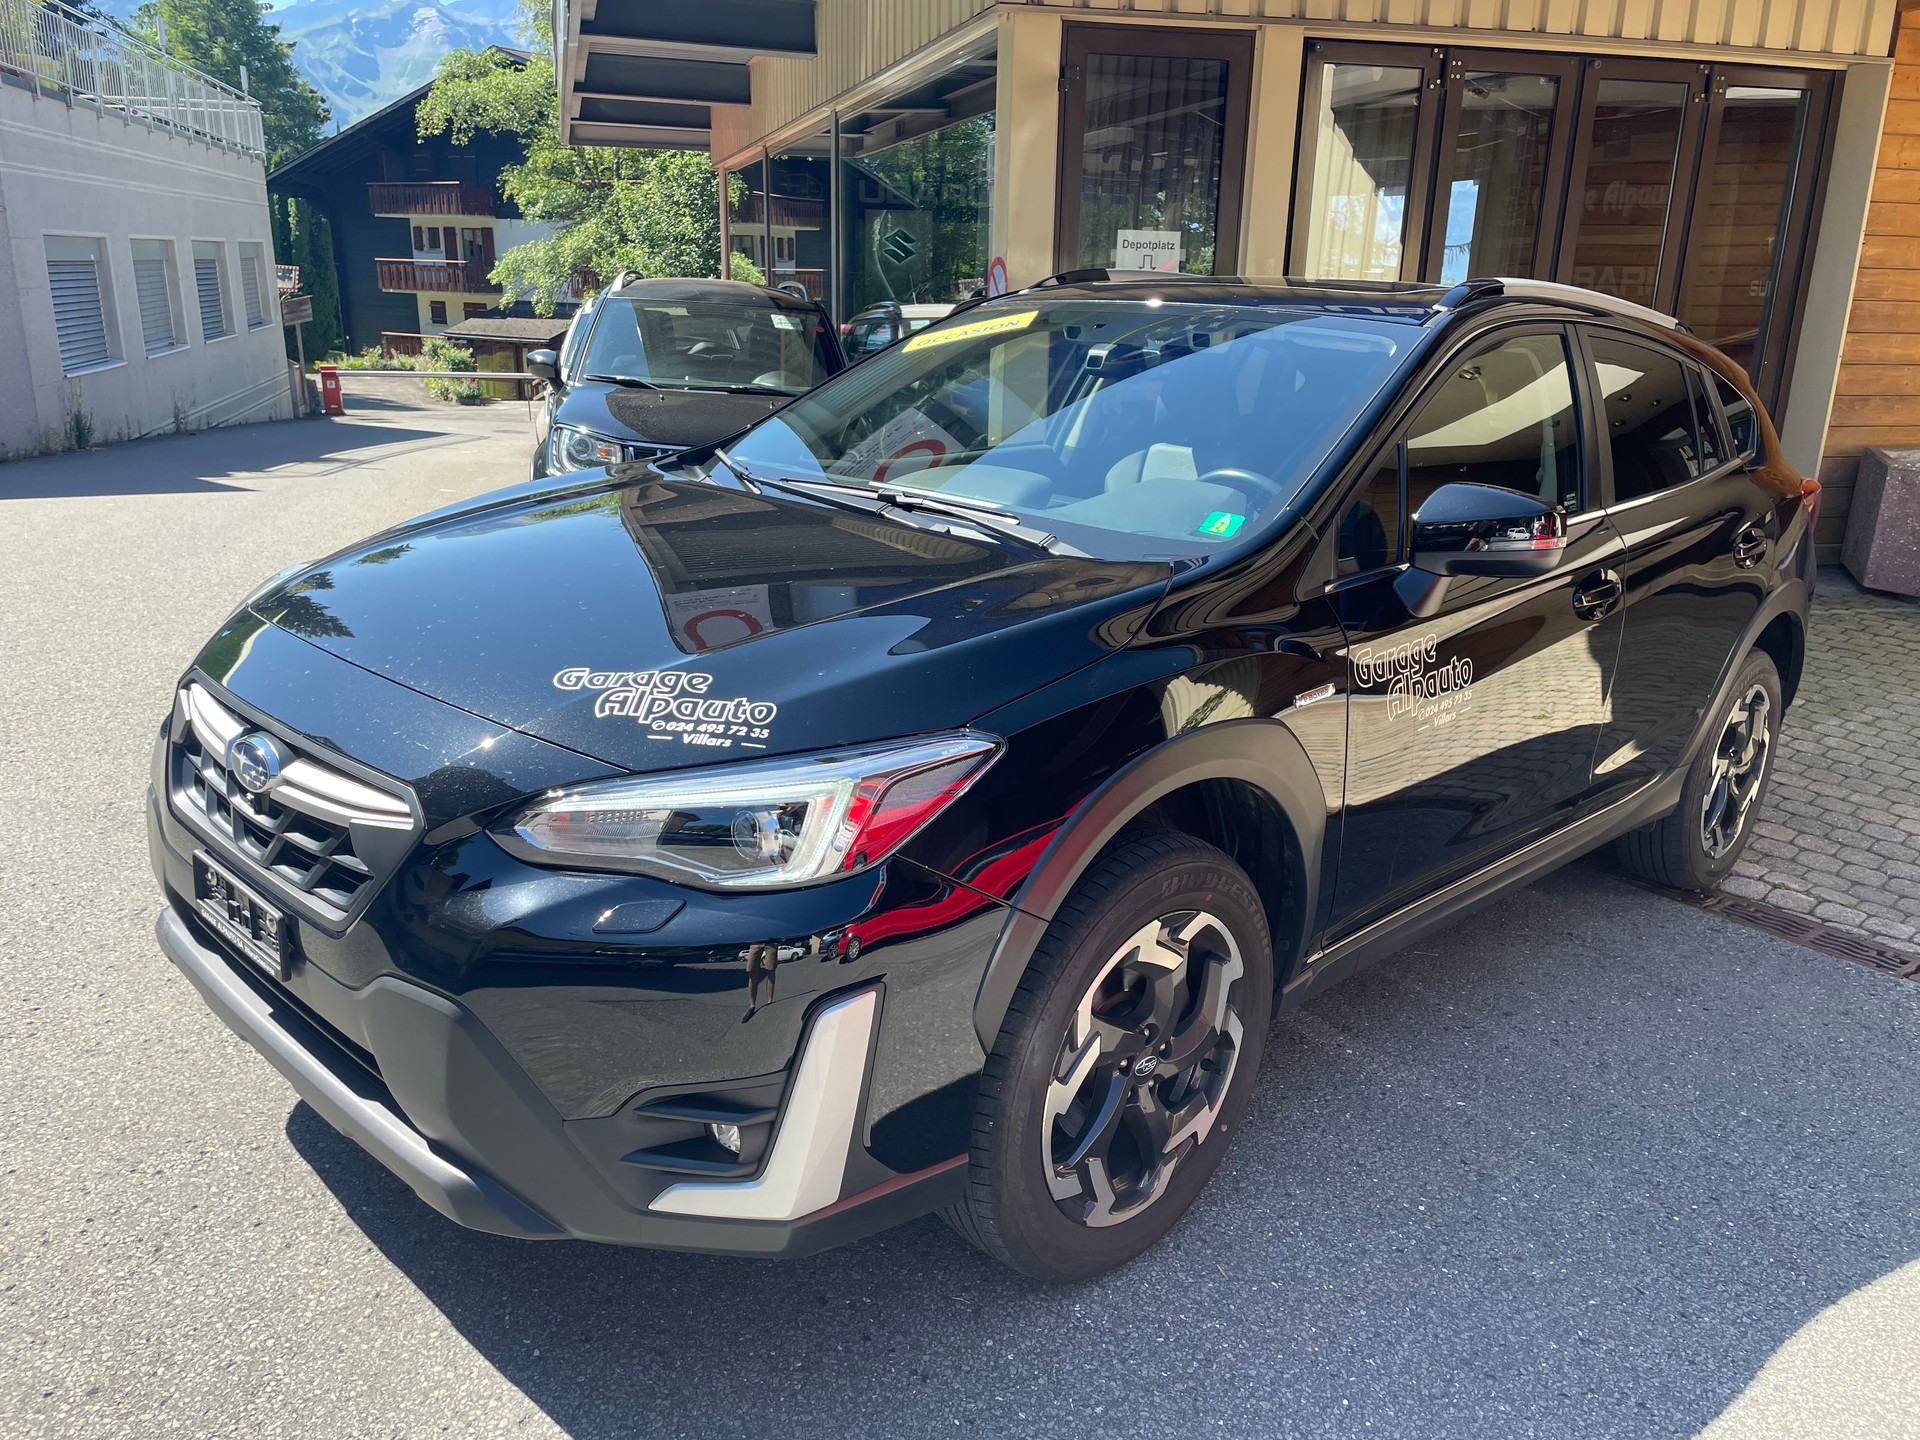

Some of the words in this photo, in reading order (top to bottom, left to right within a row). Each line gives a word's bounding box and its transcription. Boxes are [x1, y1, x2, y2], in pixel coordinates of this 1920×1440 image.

[1122, 239, 1175, 252] Depotplatz
[917, 320, 1020, 347] OCCASION
[1354, 634, 1437, 688] Garage
[553, 668, 713, 697] Garage
[1387, 656, 1473, 721] Alpauto
[594, 687, 777, 725] Alpauto
[1426, 703, 1439, 718] 024
[1440, 697, 1453, 711] 495
[1454, 693, 1463, 706] 72
[1464, 689, 1473, 701] 35
[665, 721, 695, 732] 024
[696, 723, 726, 734] 495
[727, 725, 748, 736] 72
[750, 728, 770, 739] 35
[1434, 711, 1457, 727] Villars
[682, 733, 733, 747] Villars
